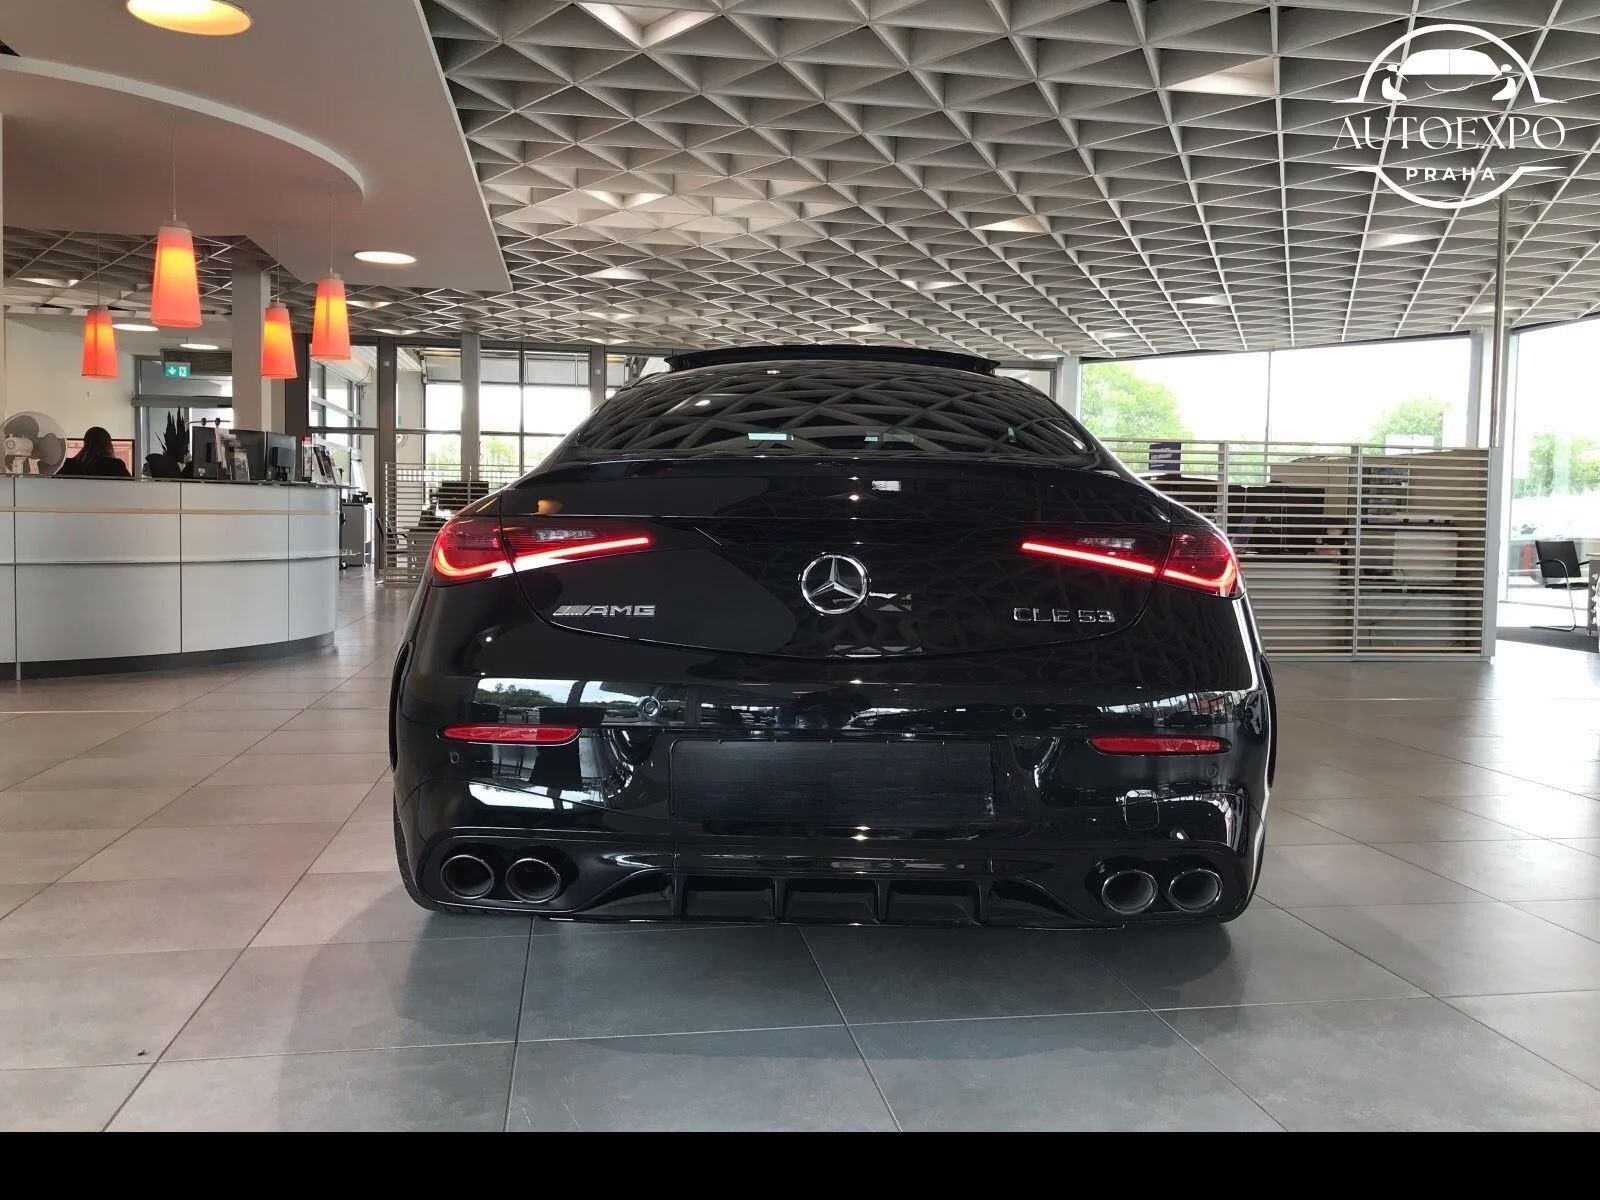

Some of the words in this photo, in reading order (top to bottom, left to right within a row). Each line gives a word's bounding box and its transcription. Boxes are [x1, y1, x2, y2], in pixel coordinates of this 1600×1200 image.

[583, 604, 656, 617] AMG
[1013, 607, 1071, 623] CLE
[1077, 608, 1116, 623] 53
